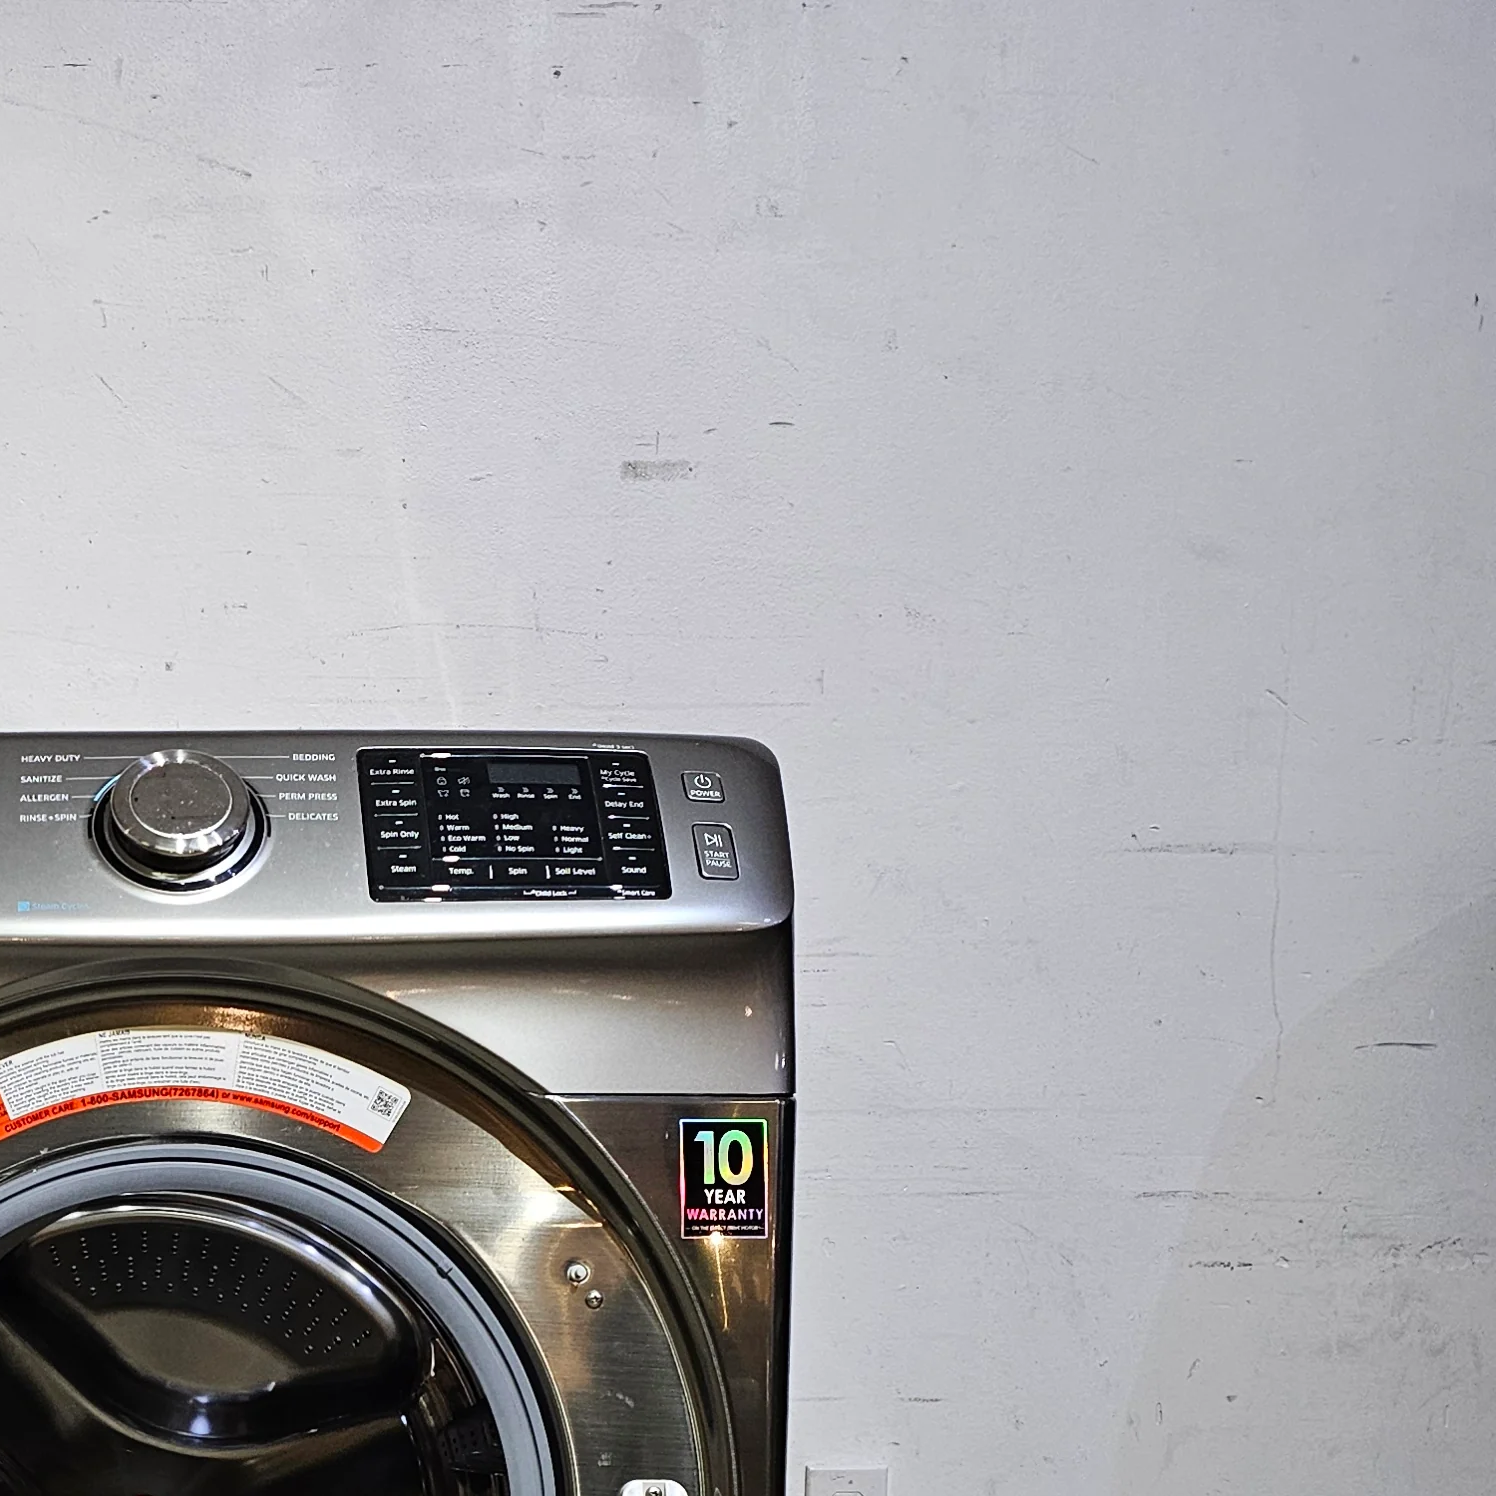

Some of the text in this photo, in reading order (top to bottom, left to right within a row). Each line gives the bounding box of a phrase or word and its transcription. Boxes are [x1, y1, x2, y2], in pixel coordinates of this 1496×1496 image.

[21, 754, 81, 763] HEAVY DUTY
[293, 753, 335, 761] BEDDING
[20, 775, 63, 783] SANITIZE
[276, 773, 305, 782] QUICK
[278, 792, 337, 800] PERM PRESS
[690, 789, 721, 797] POWER
[20, 794, 69, 802] ALLERGEN
[288, 812, 338, 821] DELICATES
[560, 825, 585, 833] Heavy
[380, 831, 419, 839] Spin Only
[704, 850, 729, 859] START
[705, 860, 732, 868] PAUSE
[391, 865, 416, 873] Steam
[449, 867, 474, 875] Temp.
[508, 867, 528, 875] Spin
[555, 867, 571, 875] Soil
[621, 866, 647, 874] Sound
[3, 1108, 50, 1133] CUSTOMER
[221, 1091, 230, 1099] or
[694, 1129, 754, 1185] 10
[704, 1189, 746, 1204] YEAR
[686, 1208, 763, 1221] WARRANTY
